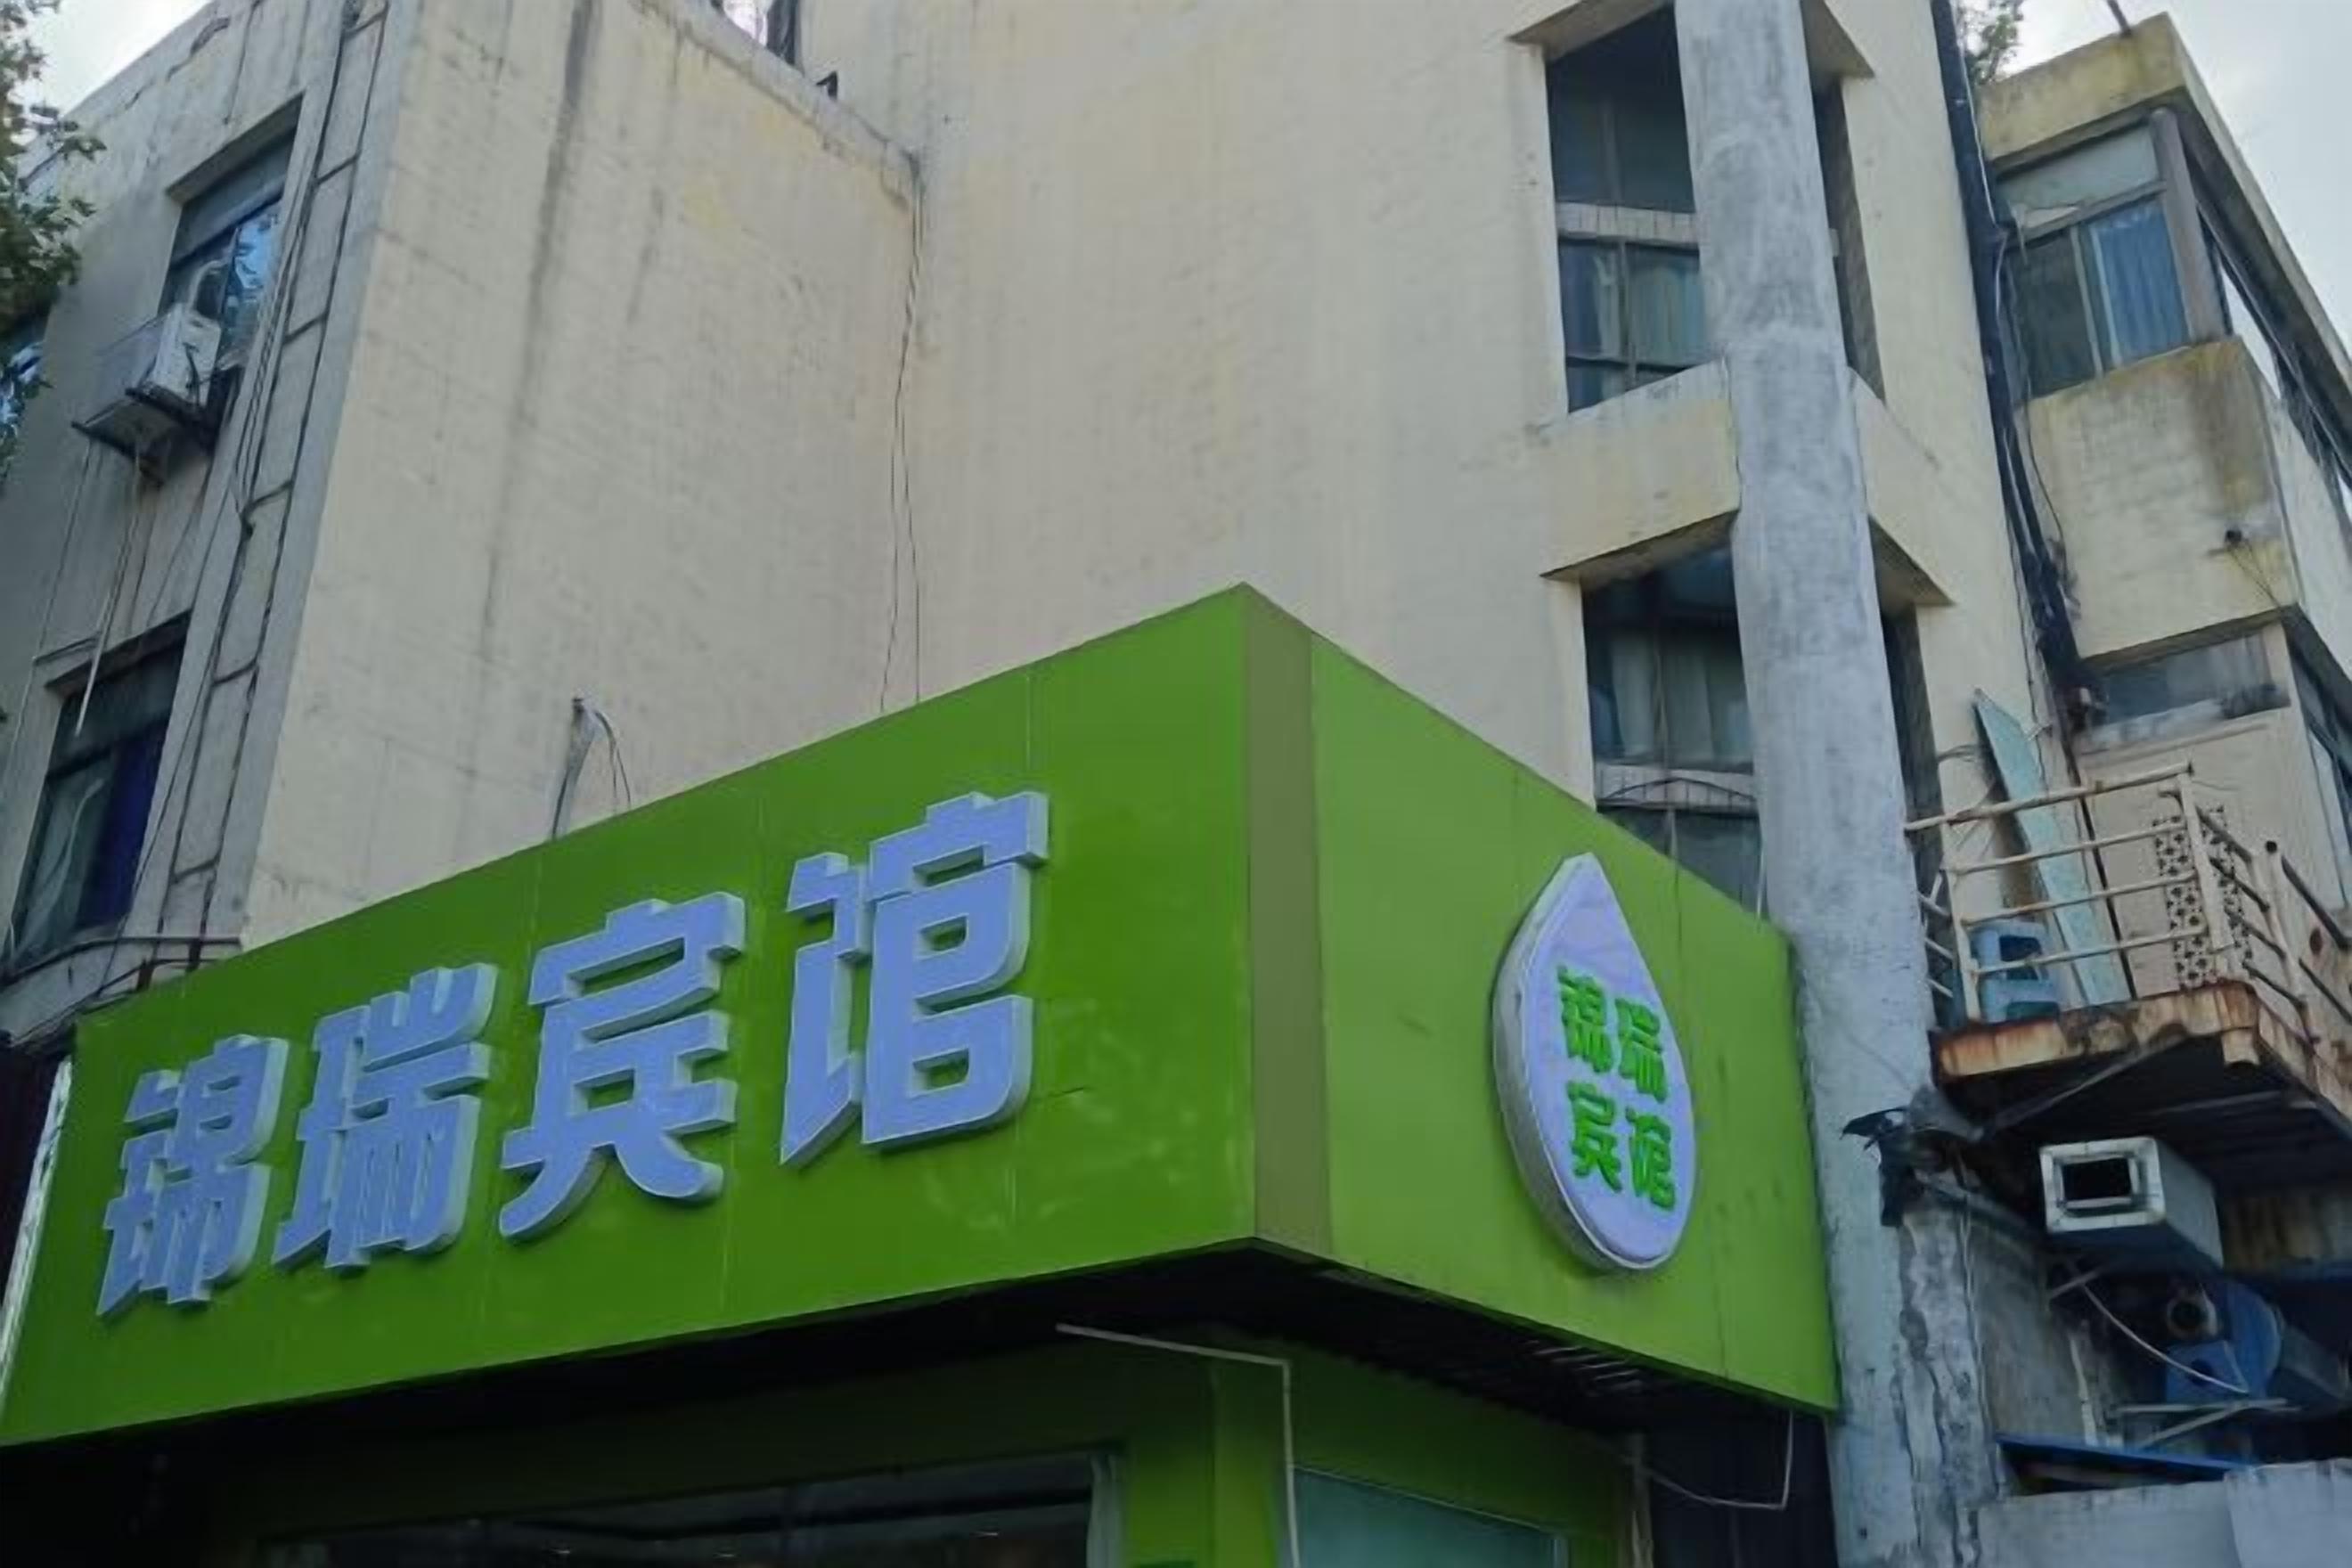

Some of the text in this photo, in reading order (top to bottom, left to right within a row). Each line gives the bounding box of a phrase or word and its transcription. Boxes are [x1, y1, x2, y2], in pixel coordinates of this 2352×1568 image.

[98, 790, 1050, 1319] 锦瑞宾馆
[1557, 963, 1669, 1103] 锦瑞
[1567, 1079, 1676, 1212] 宾馆
